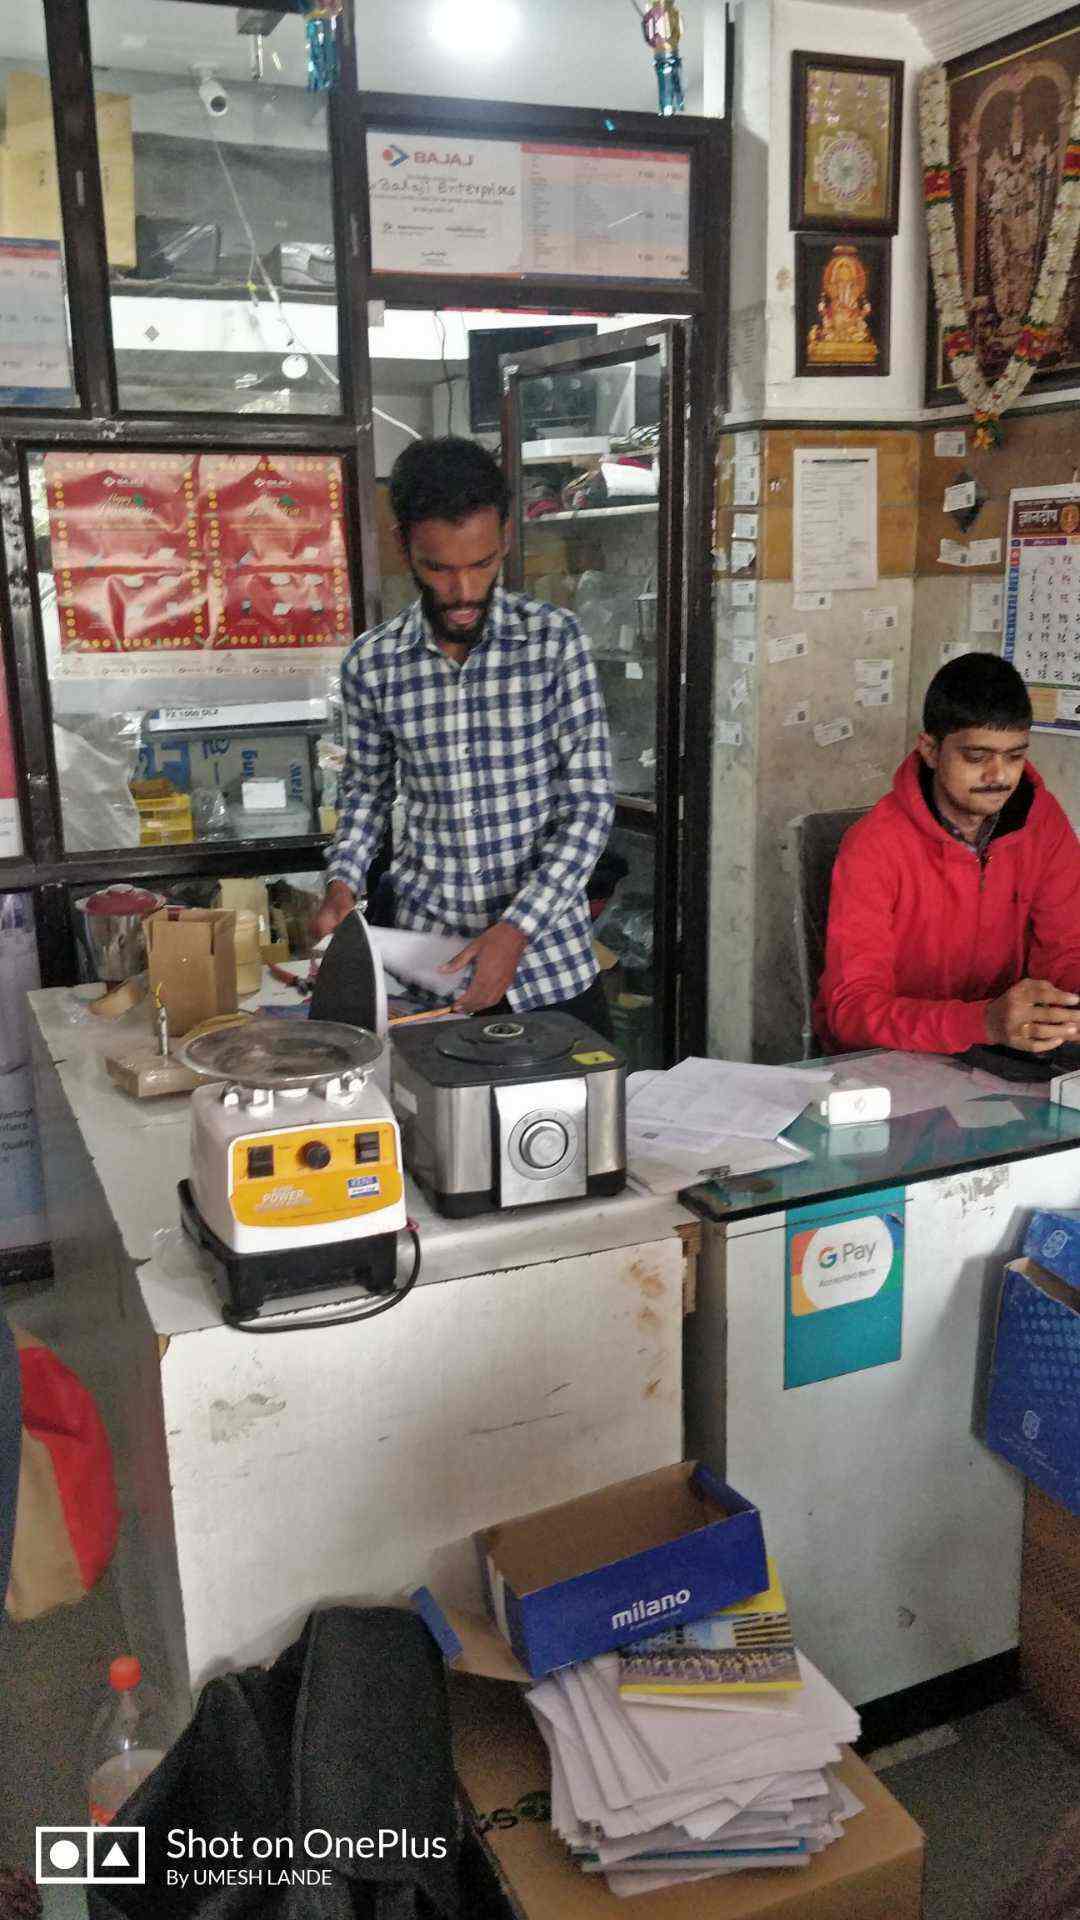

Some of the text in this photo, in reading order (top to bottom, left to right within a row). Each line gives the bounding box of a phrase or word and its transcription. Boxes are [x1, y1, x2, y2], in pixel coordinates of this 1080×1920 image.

[414, 151, 475, 167] BAJAJ
[818, 1241, 878, 1269] G Pay
[612, 1589, 691, 1630] milano
